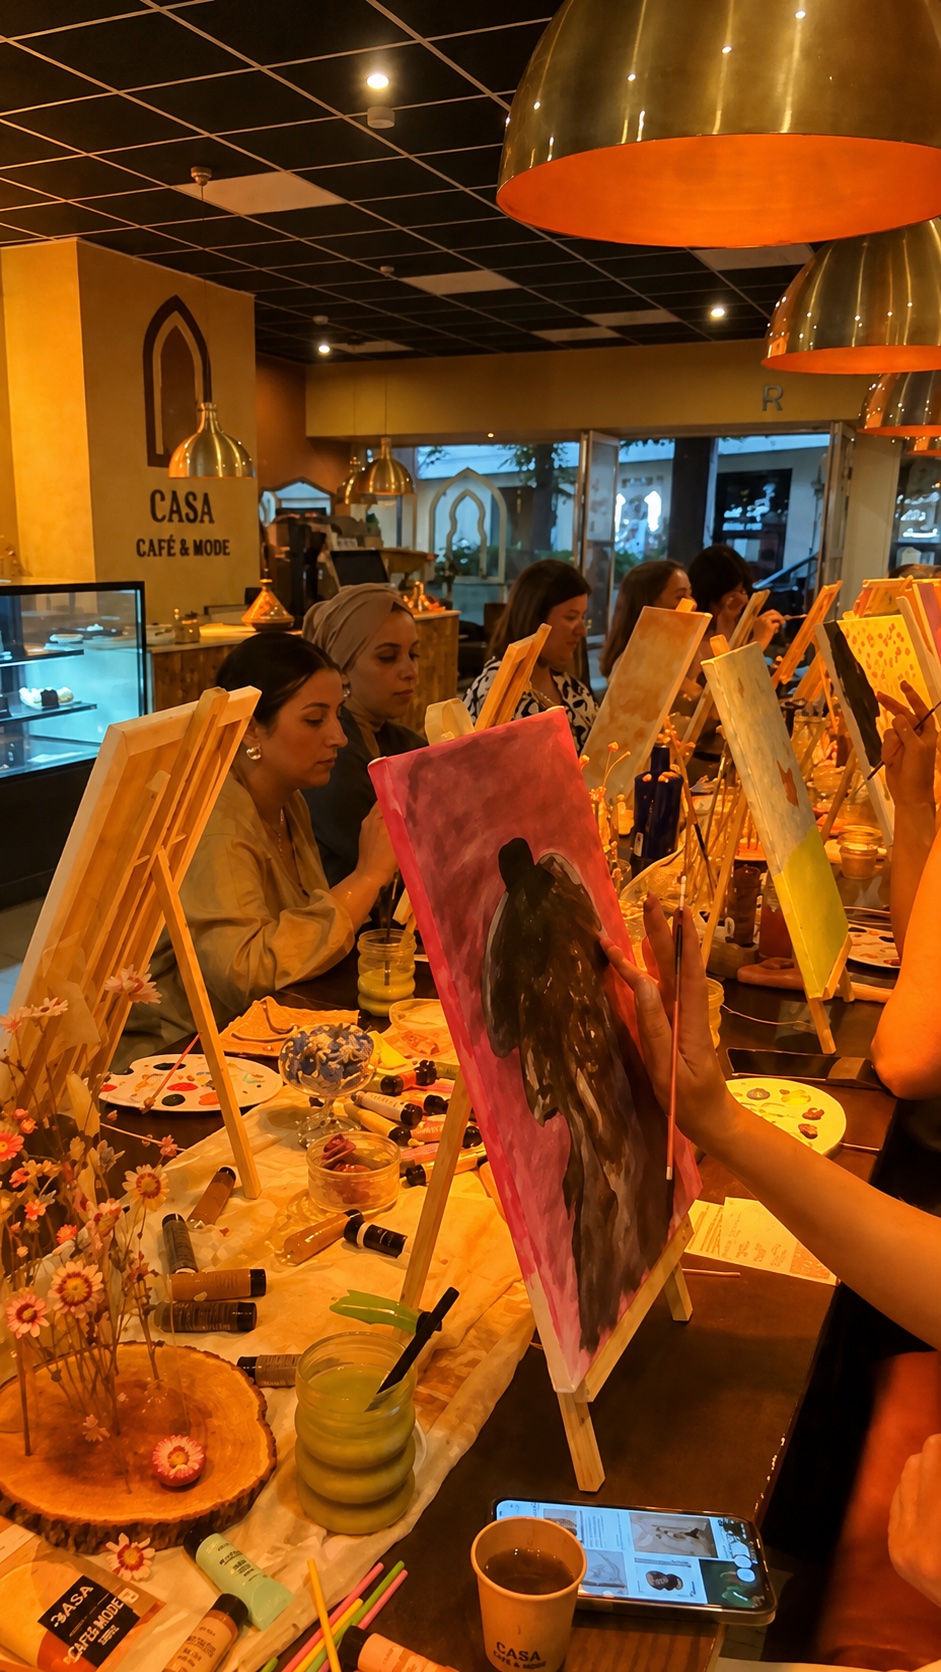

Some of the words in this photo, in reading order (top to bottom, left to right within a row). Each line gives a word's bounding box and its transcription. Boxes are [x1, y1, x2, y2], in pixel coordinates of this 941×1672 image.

[762, 384, 784, 412] R
[149, 488, 215, 524] CASA
[136, 533, 177, 558] CAFÉ
[179, 537, 190, 556] &
[193, 538, 231, 557] MODE
[93, 1597, 125, 1631] MODE
[496, 1641, 541, 1662] CASA
